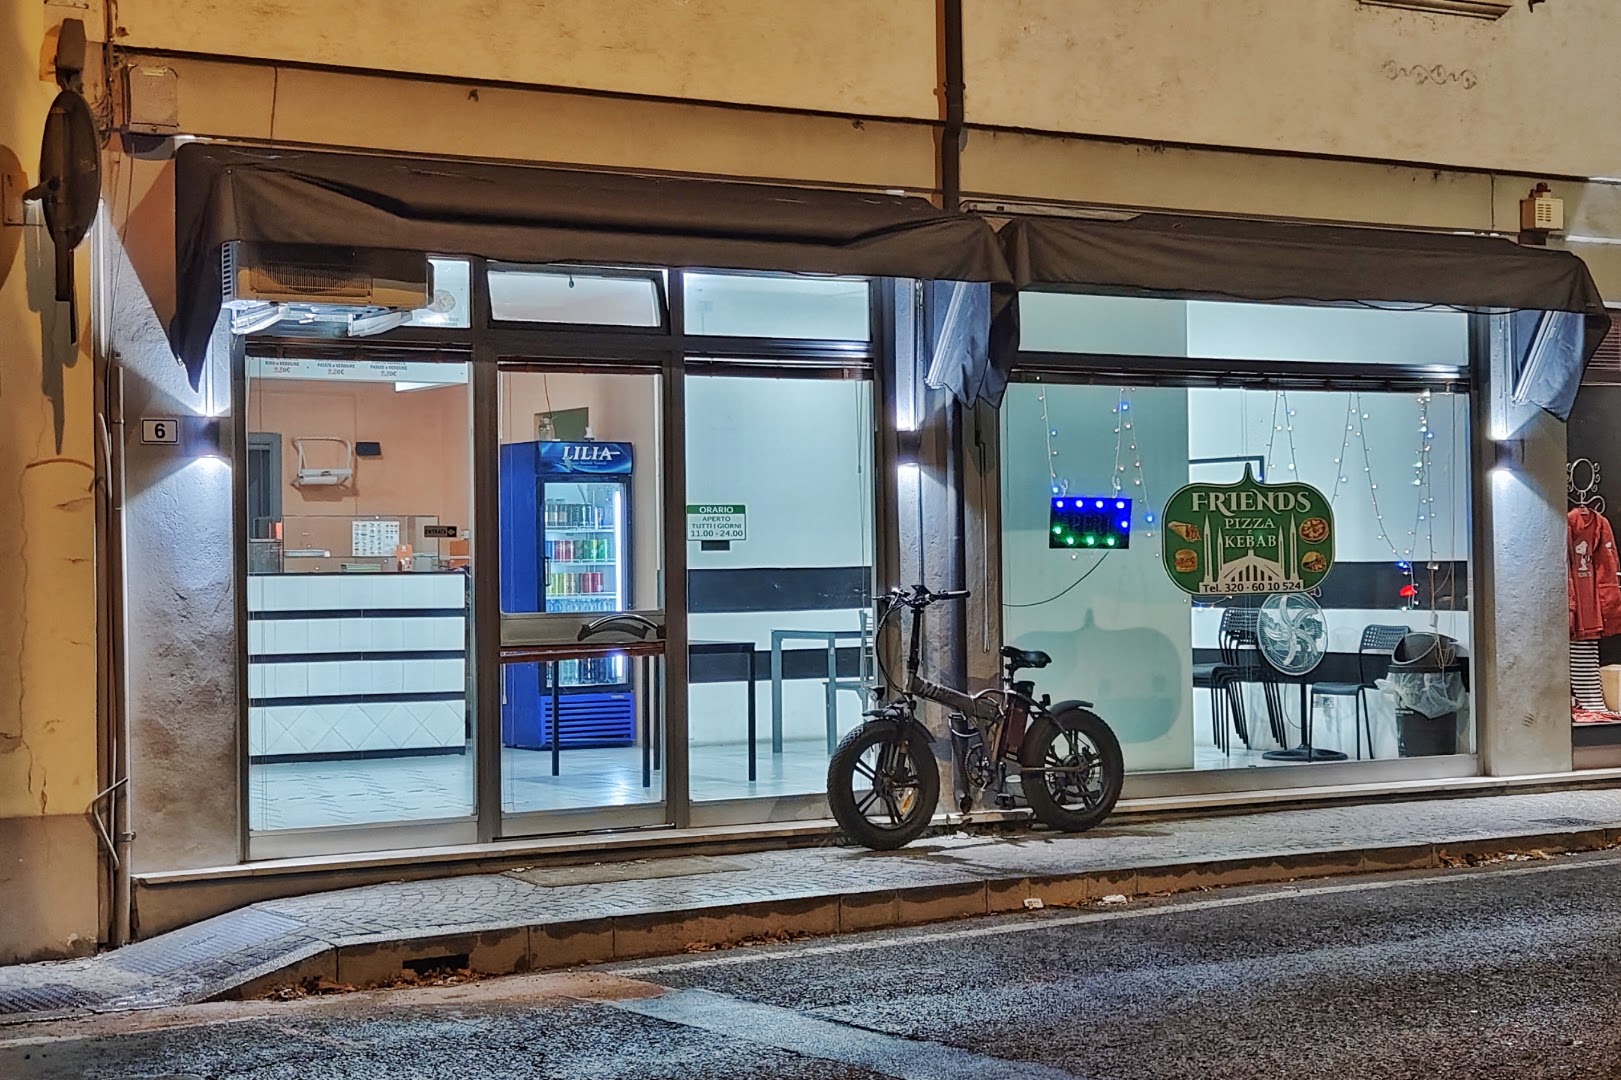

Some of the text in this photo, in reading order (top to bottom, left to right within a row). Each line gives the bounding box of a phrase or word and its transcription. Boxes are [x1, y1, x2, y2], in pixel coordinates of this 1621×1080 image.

[154, 423, 166, 439] 6
[561, 446, 620, 461] LILIA
[1191, 488, 1311, 516] FRIENDS
[699, 506, 734, 514] ORARIO
[1224, 518, 1276, 529] PIZZA
[1225, 535, 1277, 548] KEBAB
[1202, 584, 1222, 593] Tel.
[1225, 583, 1243, 592] 320
[1251, 583, 1265, 591] 60
[1267, 583, 1280, 591] 10
[1282, 582, 1301, 591] 524
